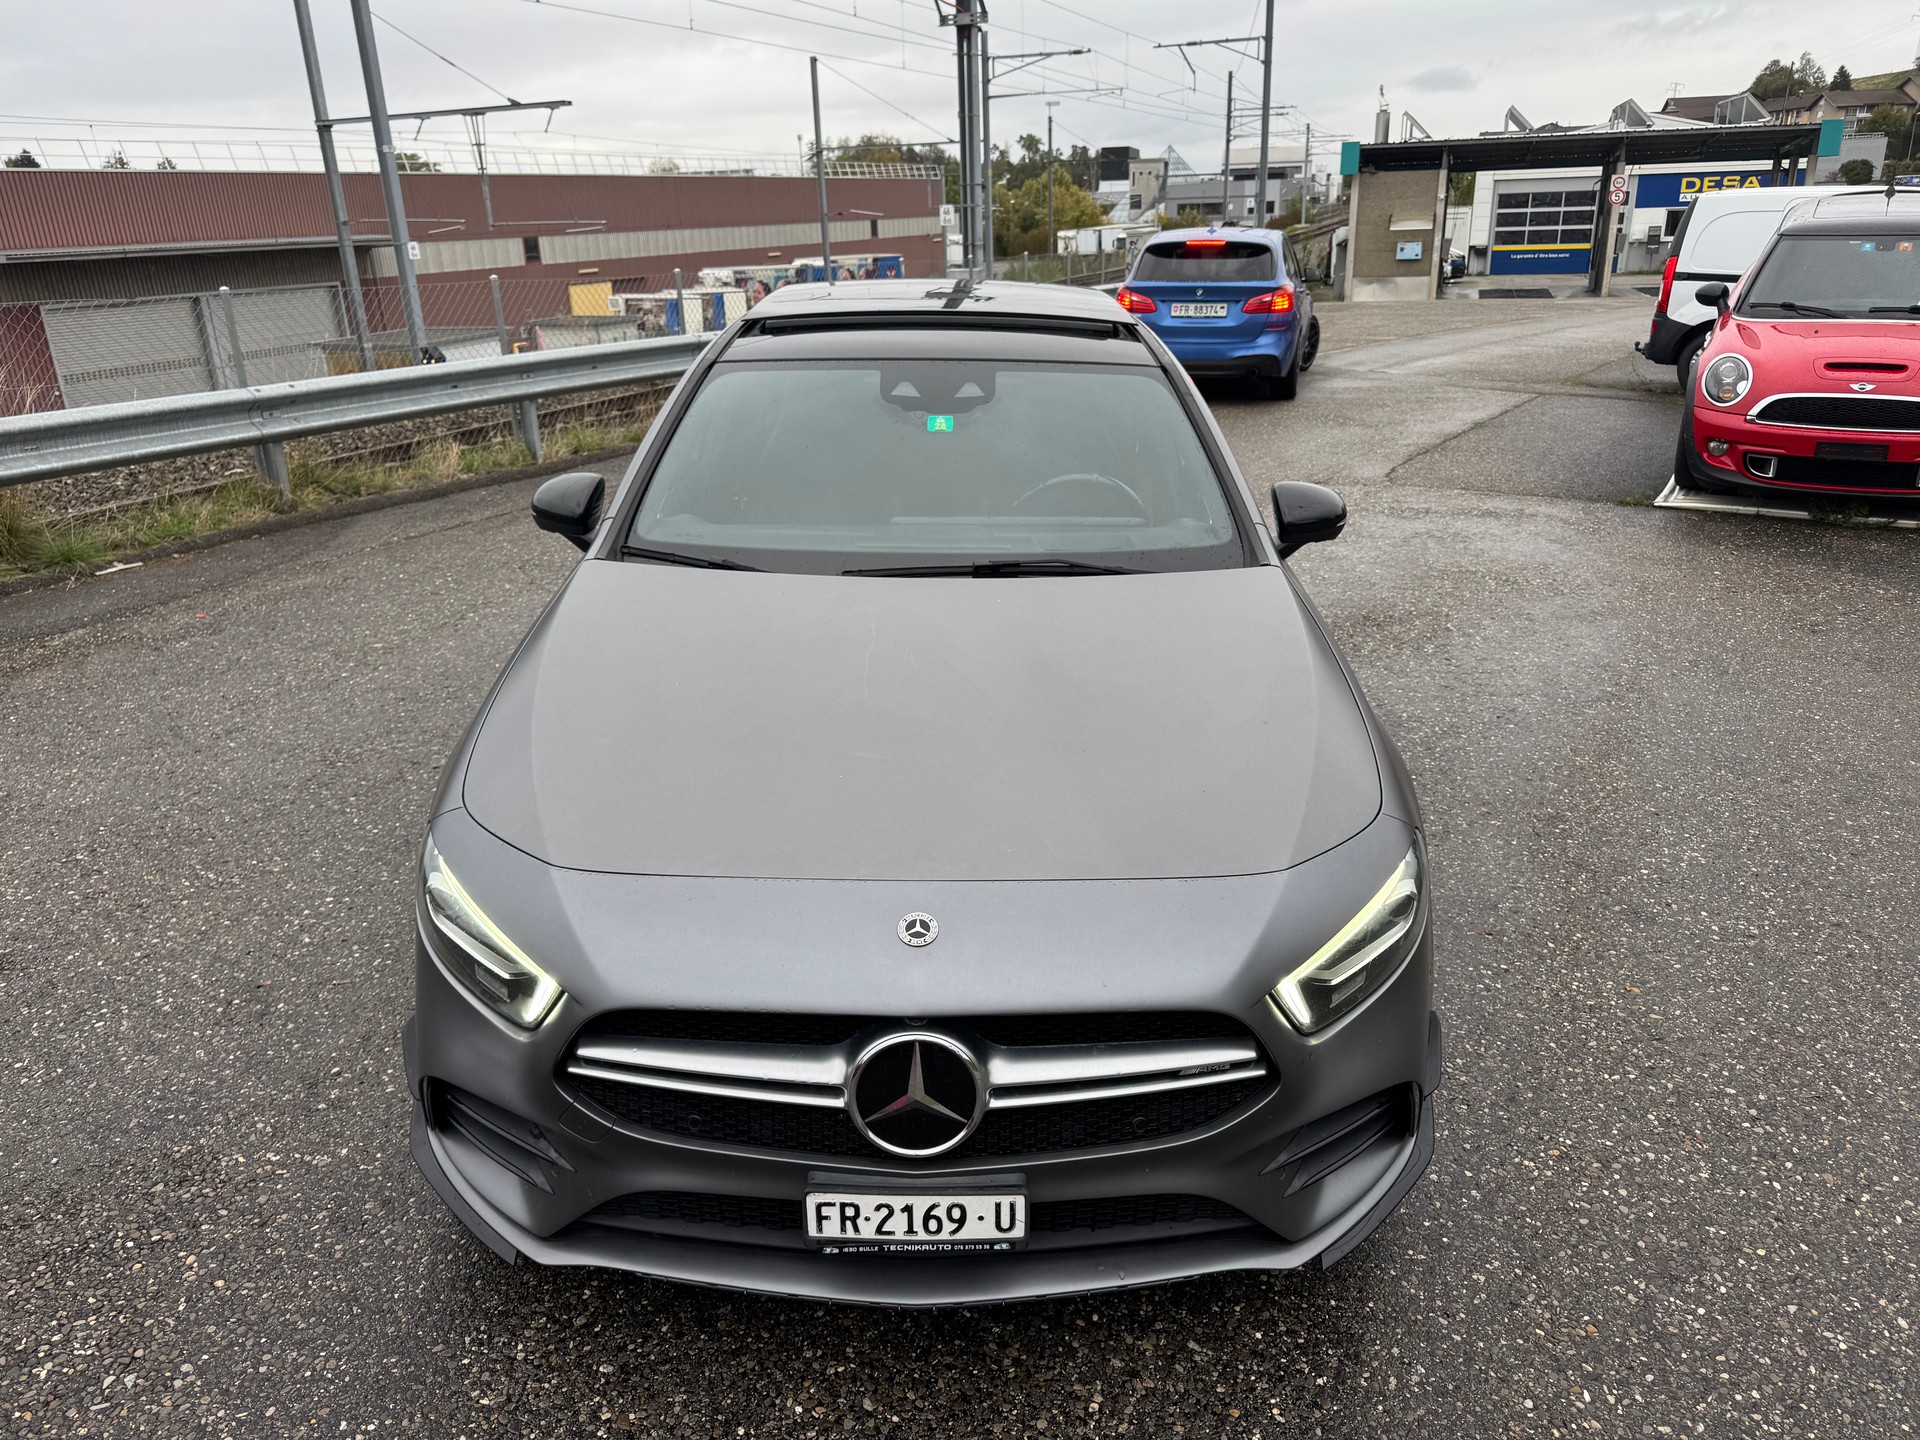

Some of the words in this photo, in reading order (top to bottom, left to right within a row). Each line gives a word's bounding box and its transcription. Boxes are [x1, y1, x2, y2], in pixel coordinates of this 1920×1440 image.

[1681, 176, 1760, 193] DESA
[1614, 192, 1621, 201] 5
[882, 1244, 952, 1252] TECNIKAUTO
